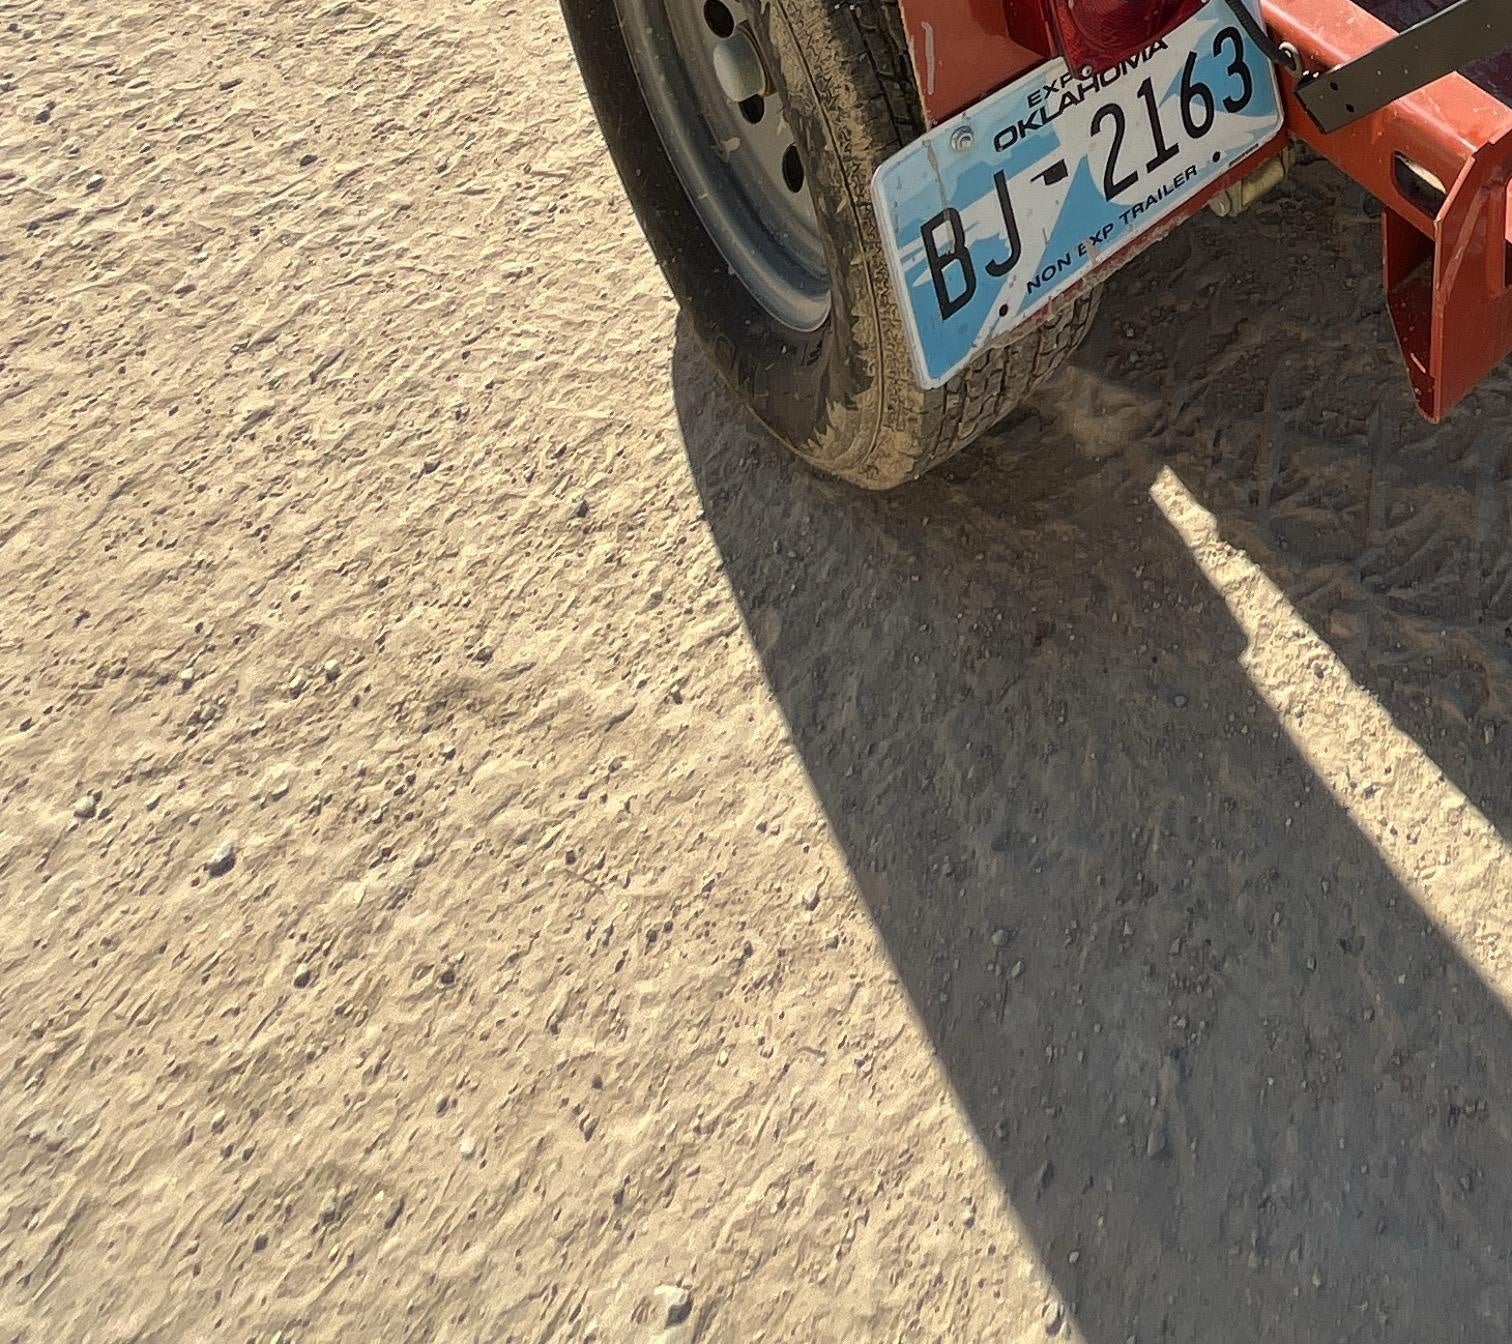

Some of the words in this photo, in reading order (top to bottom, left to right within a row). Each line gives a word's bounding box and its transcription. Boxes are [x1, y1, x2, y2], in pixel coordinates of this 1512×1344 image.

[993, 38, 1169, 153] OKLAHOMA
[920, 170, 1022, 321] BJ
[1090, 26, 1253, 202] 2163
[1026, 251, 1071, 295] NON
[1078, 222, 1114, 258] EXP
[1119, 164, 1198, 226] TRAILER
